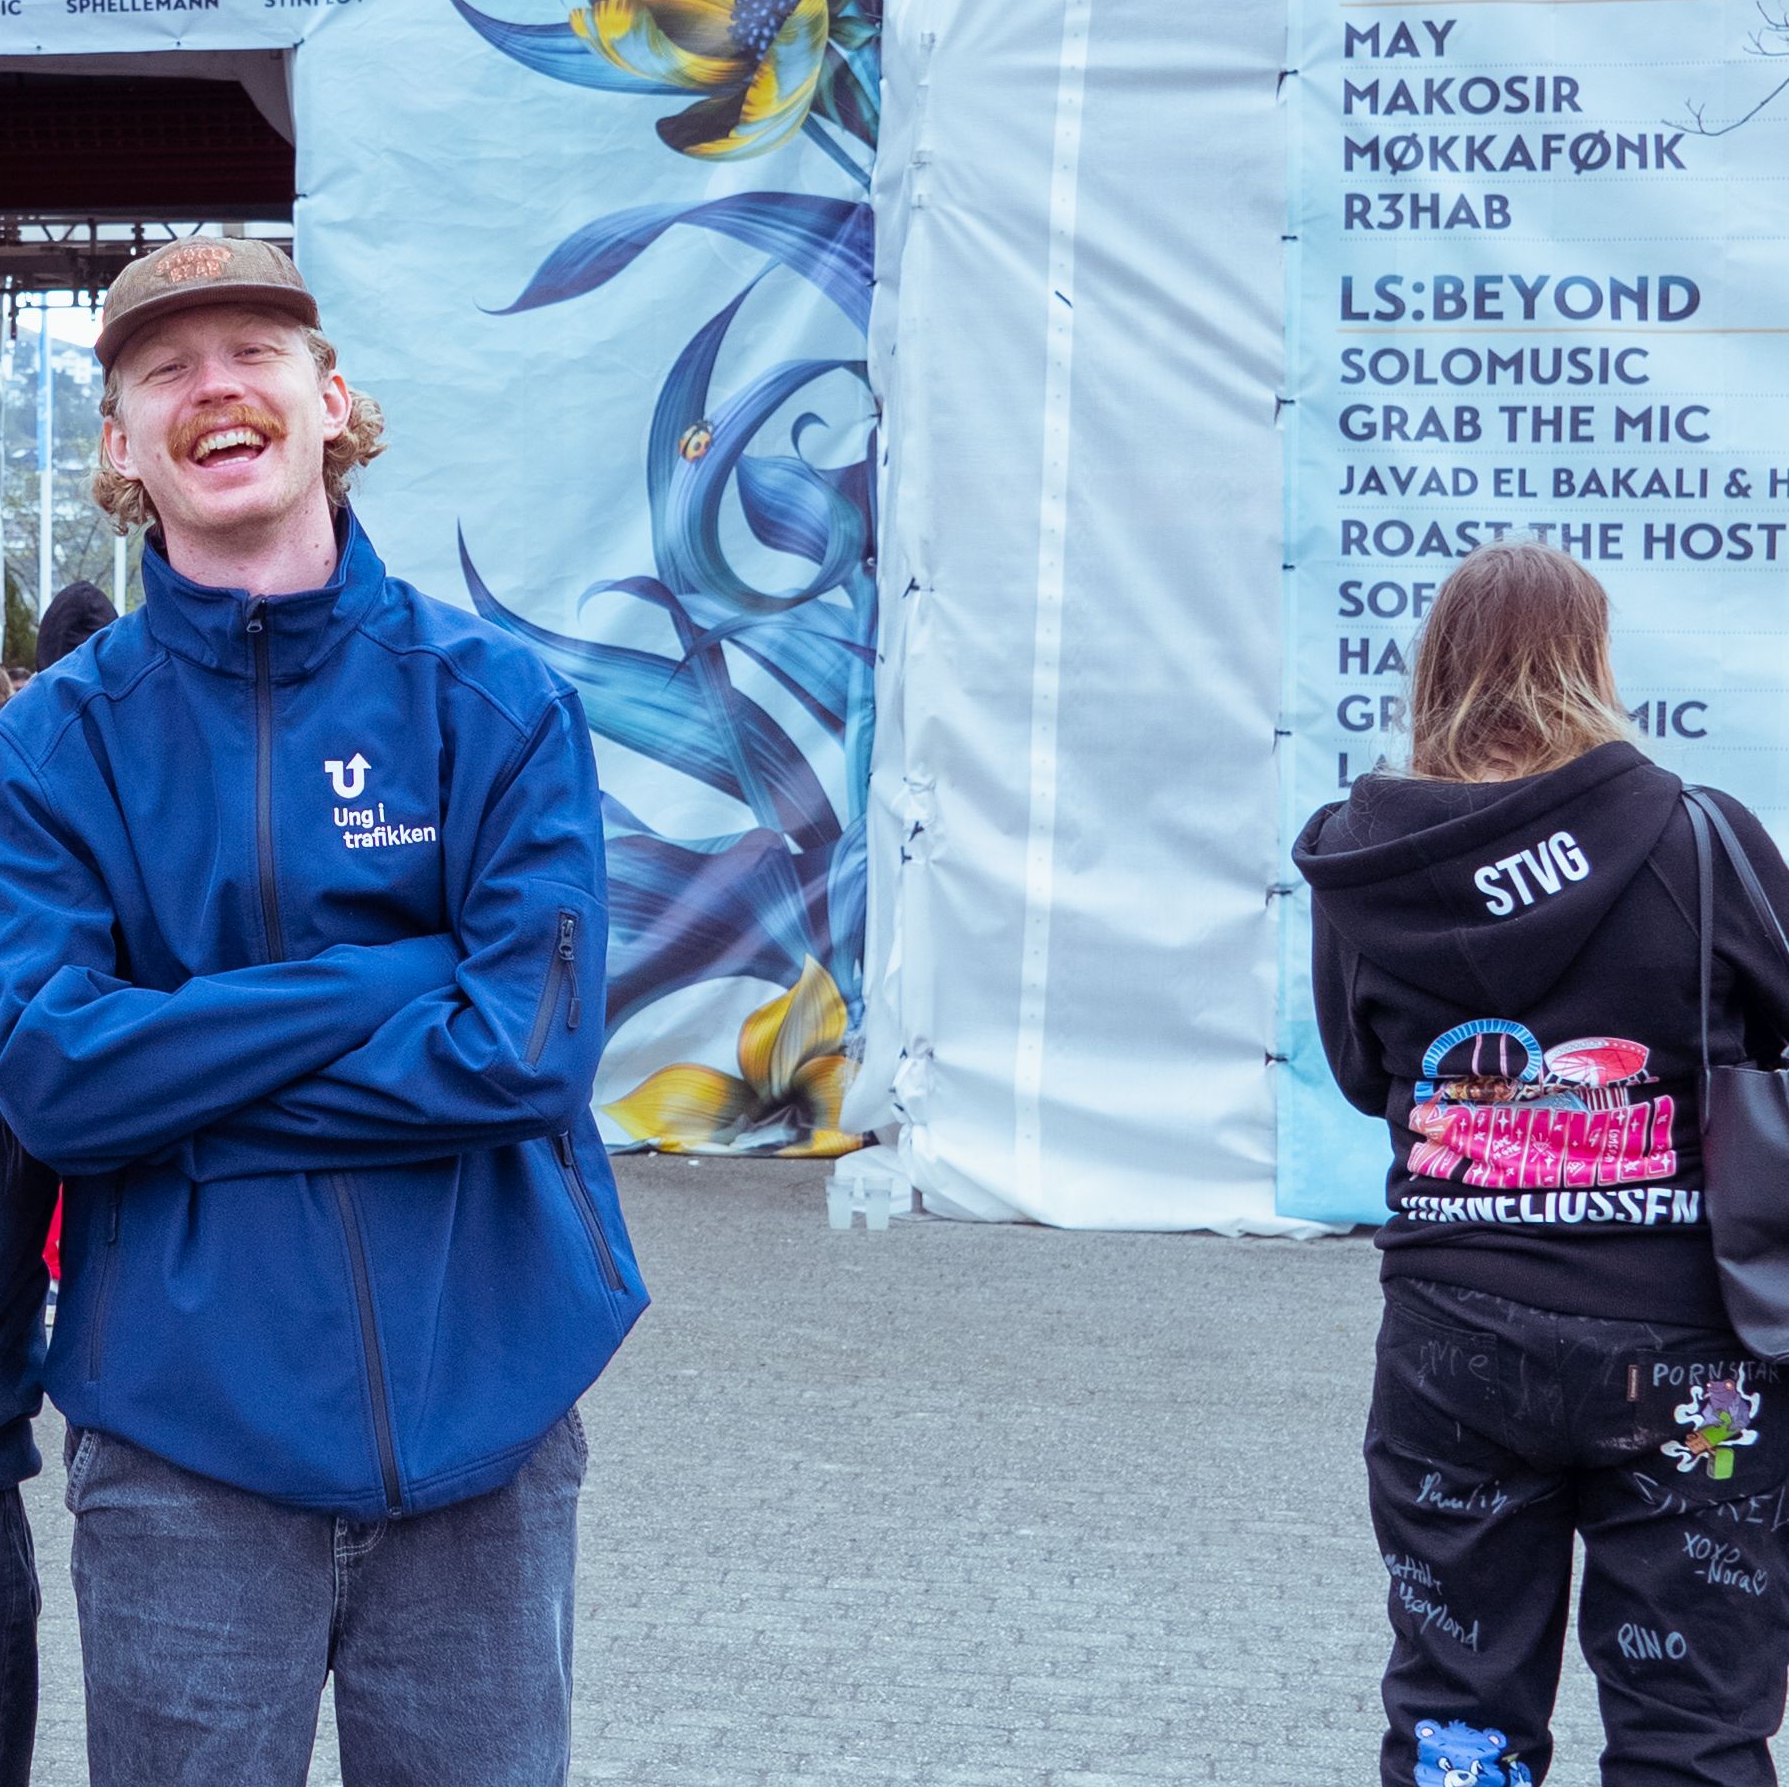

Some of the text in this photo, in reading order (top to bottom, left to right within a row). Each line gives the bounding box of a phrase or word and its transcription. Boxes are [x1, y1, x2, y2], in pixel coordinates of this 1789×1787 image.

[1344, 19, 1457, 59] MAY
[1343, 75, 1584, 116] MAKOSIR
[1343, 129, 1687, 176] MØKKAFØNK
[1343, 192, 1512, 231] R3HAB
[1341, 274, 1701, 323] LS:BEYOND
[1339, 347, 1651, 386] SOLOMUSIC
[1338, 403, 1712, 443] GRAB THE MIC
[1338, 465, 1479, 498] JAVAD
[1493, 467, 1538, 499] EL
[1552, 467, 1708, 499] BAKALI
[1723, 468, 1753, 499] &
[1643, 522, 1788, 561] HOST
[333, 802, 386, 829] Ung i
[342, 823, 437, 850] trafikken
[1473, 830, 1591, 917] STVG
[1617, 1622, 1688, 1661] RINO
